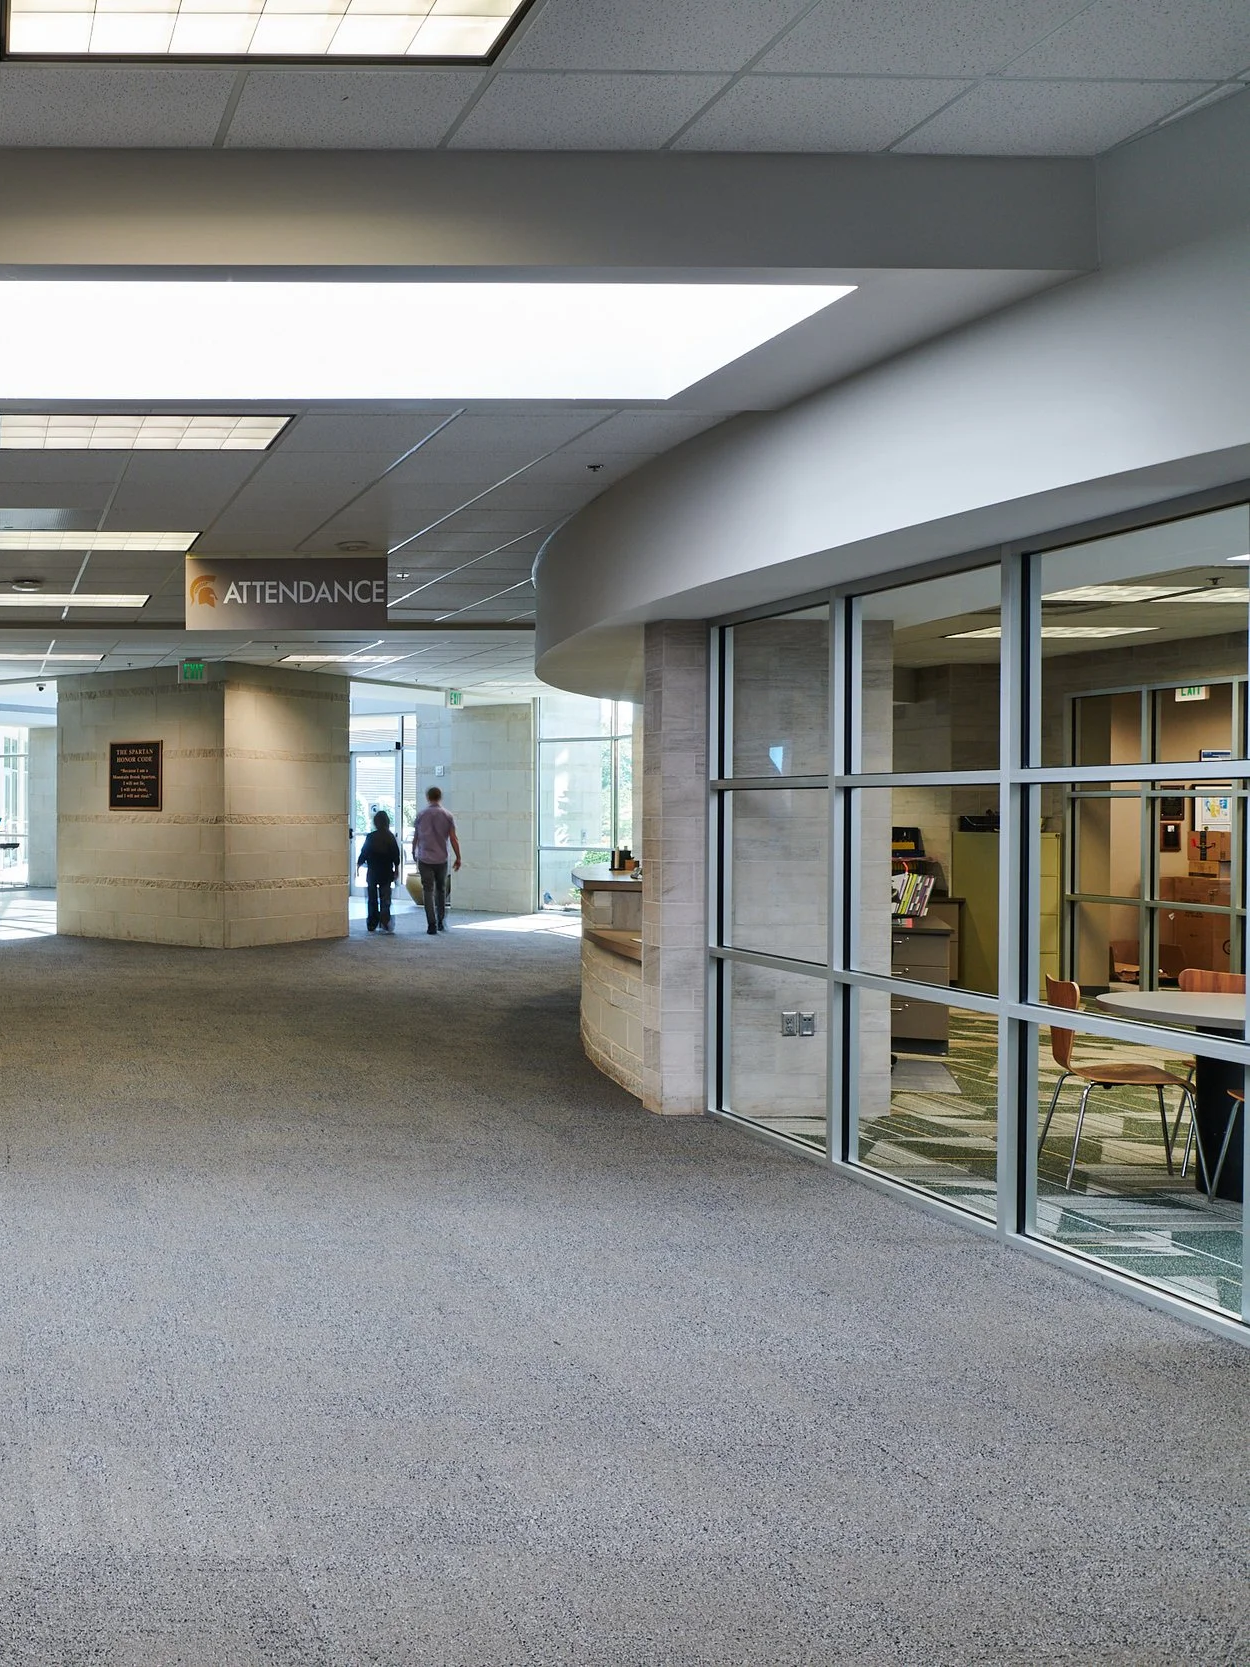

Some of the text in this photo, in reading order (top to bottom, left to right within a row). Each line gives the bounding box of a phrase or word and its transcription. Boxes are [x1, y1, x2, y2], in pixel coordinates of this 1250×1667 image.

[223, 580, 385, 604] ATTENDANCE
[183, 663, 205, 680] EXIT
[450, 692, 461, 705] EXIT
